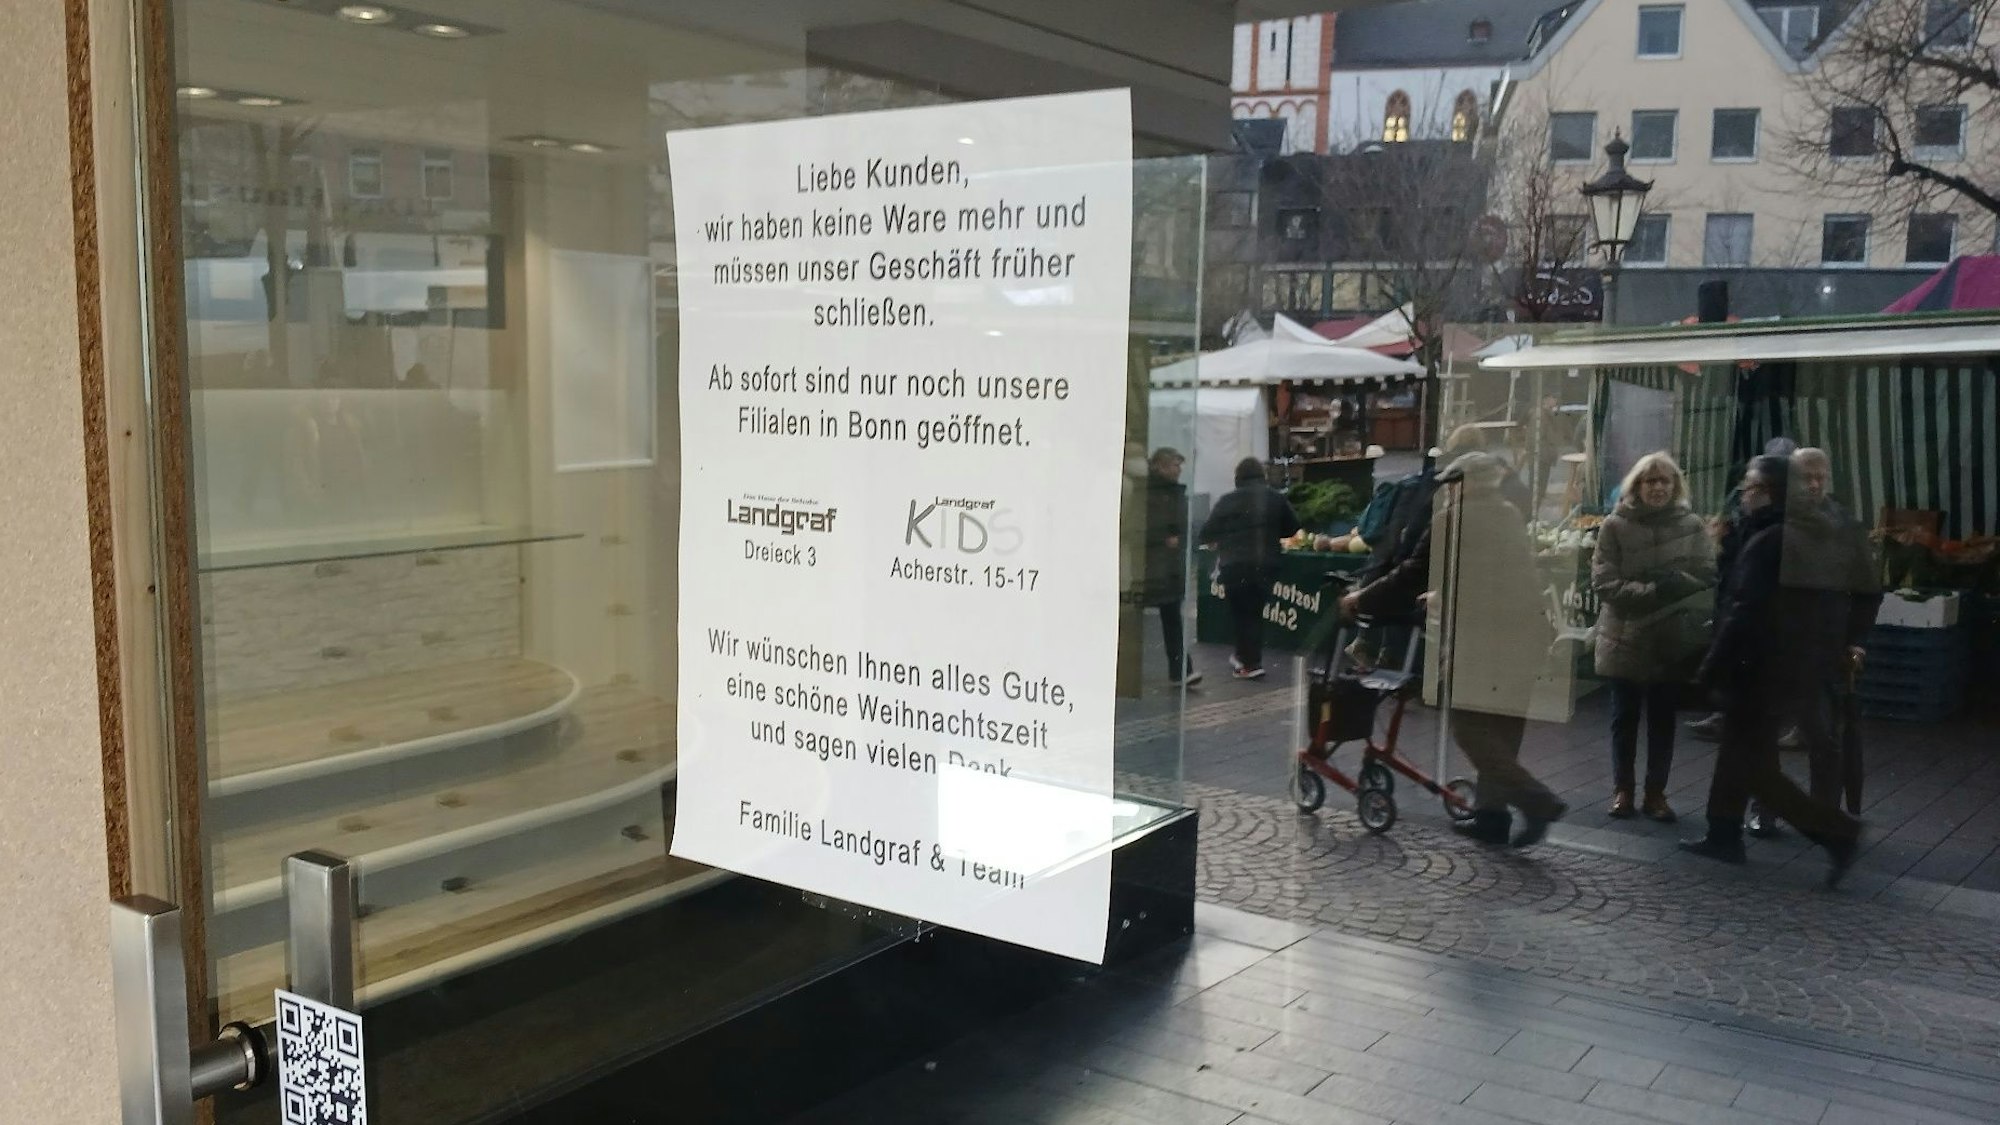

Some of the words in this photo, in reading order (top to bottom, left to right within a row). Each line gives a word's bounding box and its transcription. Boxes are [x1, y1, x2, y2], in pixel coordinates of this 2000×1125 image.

[797, 161, 856, 194] Liebe
[867, 154, 969, 189] Kunden,
[704, 213, 734, 243] wir
[741, 212, 803, 242] haben
[812, 206, 873, 238] keine
[882, 203, 947, 235] Ware
[958, 198, 1025, 232] mehr
[1036, 195, 1086, 229] und
[714, 256, 789, 285] müssen
[798, 259, 860, 282] unser
[869, 248, 981, 282] Geschäft
[991, 246, 1076, 279] früher
[813, 296, 934, 327] schließen.
[708, 363, 733, 391] Ab
[740, 363, 797, 393] sofort
[805, 365, 850, 395] sind
[860, 373, 898, 396] nur
[907, 367, 965, 398] noch
[977, 375, 1069, 401] unsere
[738, 405, 810, 437] Filialen
[819, 408, 838, 439] in
[848, 410, 907, 442] Bonn
[917, 413, 1031, 450] geöffnet.
[727, 498, 838, 536] Landgraf
[934, 495, 996, 511] Landgraf
[905, 498, 1024, 556] KIDS
[744, 539, 801, 566] Dreieck
[807, 545, 817, 568] 3
[889, 556, 974, 586] Acherstr.
[983, 565, 1039, 592] 15-17
[707, 627, 740, 657] Wir
[746, 636, 847, 676] wünschen
[858, 650, 921, 687] Ihnen
[931, 663, 991, 697] alles
[1002, 671, 1074, 714] Gute,
[726, 672, 766, 702] eine
[774, 682, 848, 717] schöne
[857, 692, 1049, 750] Weihnachtszeit
[751, 720, 786, 746] und
[794, 729, 857, 762] sagen
[866, 738, 937, 775] vielen
[739, 800, 812, 842] Familie
[821, 818, 922, 867] Landgraf
[930, 843, 946, 873] &
